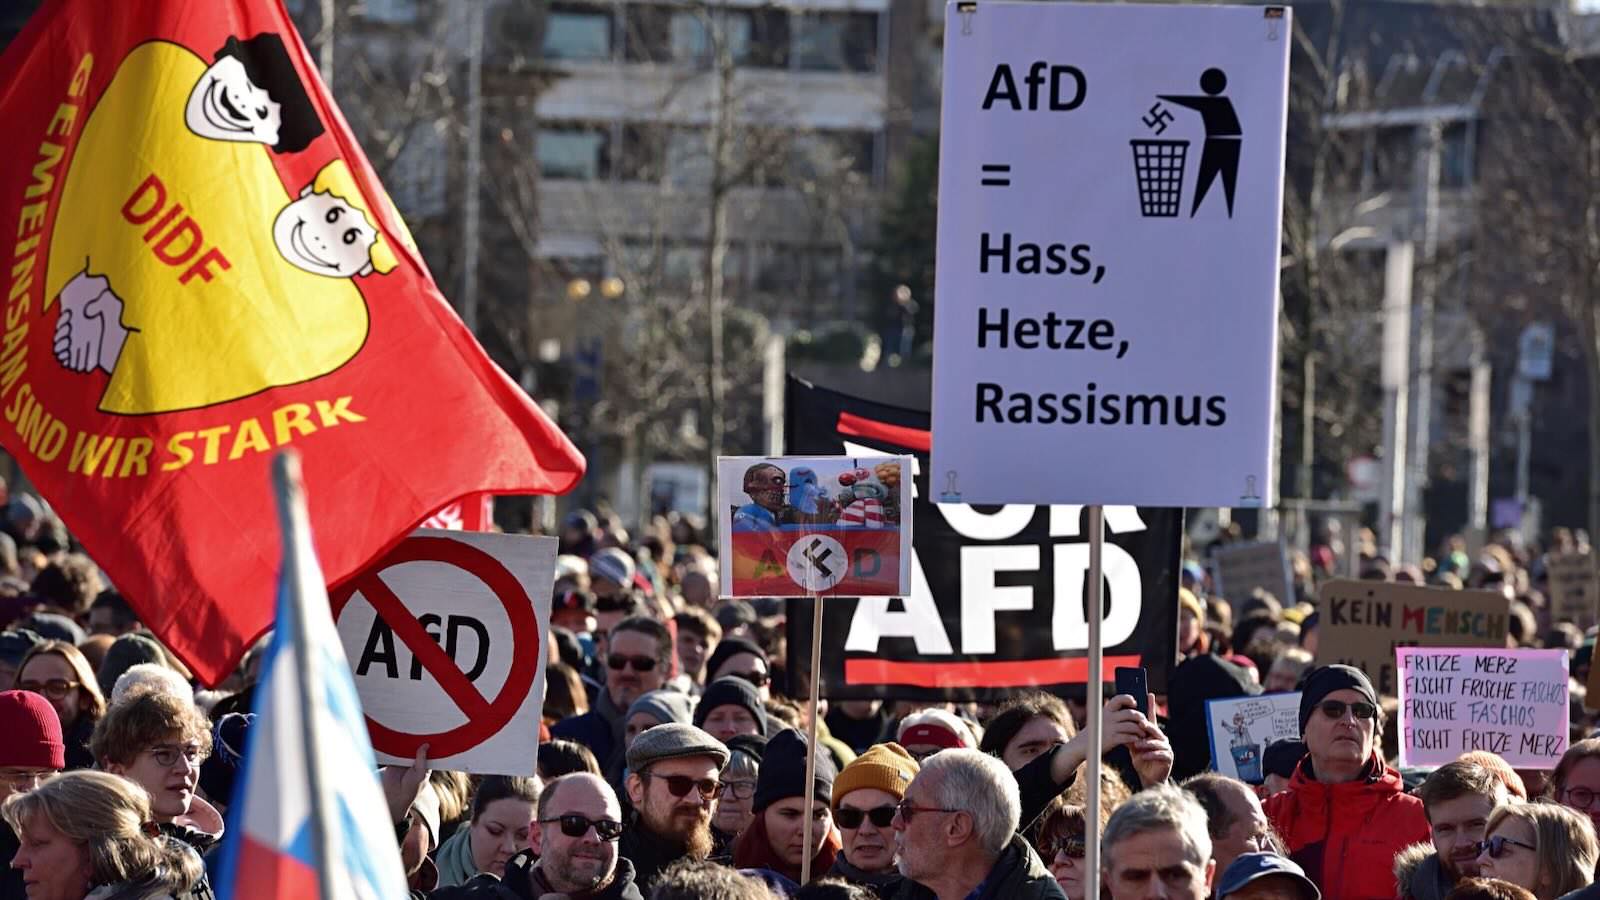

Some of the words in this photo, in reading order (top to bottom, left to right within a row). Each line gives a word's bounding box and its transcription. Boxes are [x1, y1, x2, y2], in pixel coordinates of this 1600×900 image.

[982, 61, 1087, 111] AfD
[0, 52, 93, 398] GEMEINSAM
[121, 173, 232, 285] DIDF
[979, 233, 1106, 284] Hass,
[978, 308, 1130, 359] Hetze,
[5, 383, 68, 462] SIND
[975, 383, 1227, 427] Rassismus
[68, 431, 153, 478] WIR
[162, 396, 367, 471] STARK
[845, 542, 1142, 655] AFD
[1401, 604, 1507, 640] MENSCH
[356, 613, 490, 681] AfD
[1404, 655, 1461, 672] FRITZE
[1475, 656, 1518, 674] MERZ
[1404, 699, 1457, 721] FRISCHE
[1467, 701, 1536, 728] FASCHOS
[1405, 676, 1454, 695] FISCHT
[1461, 678, 1517, 701] FRISCHE
[1520, 681, 1567, 706] FASCHOS
[1403, 727, 1452, 750] FISCHT
[1462, 728, 1513, 754] FRITZE
[1520, 732, 1564, 758] MERZ
